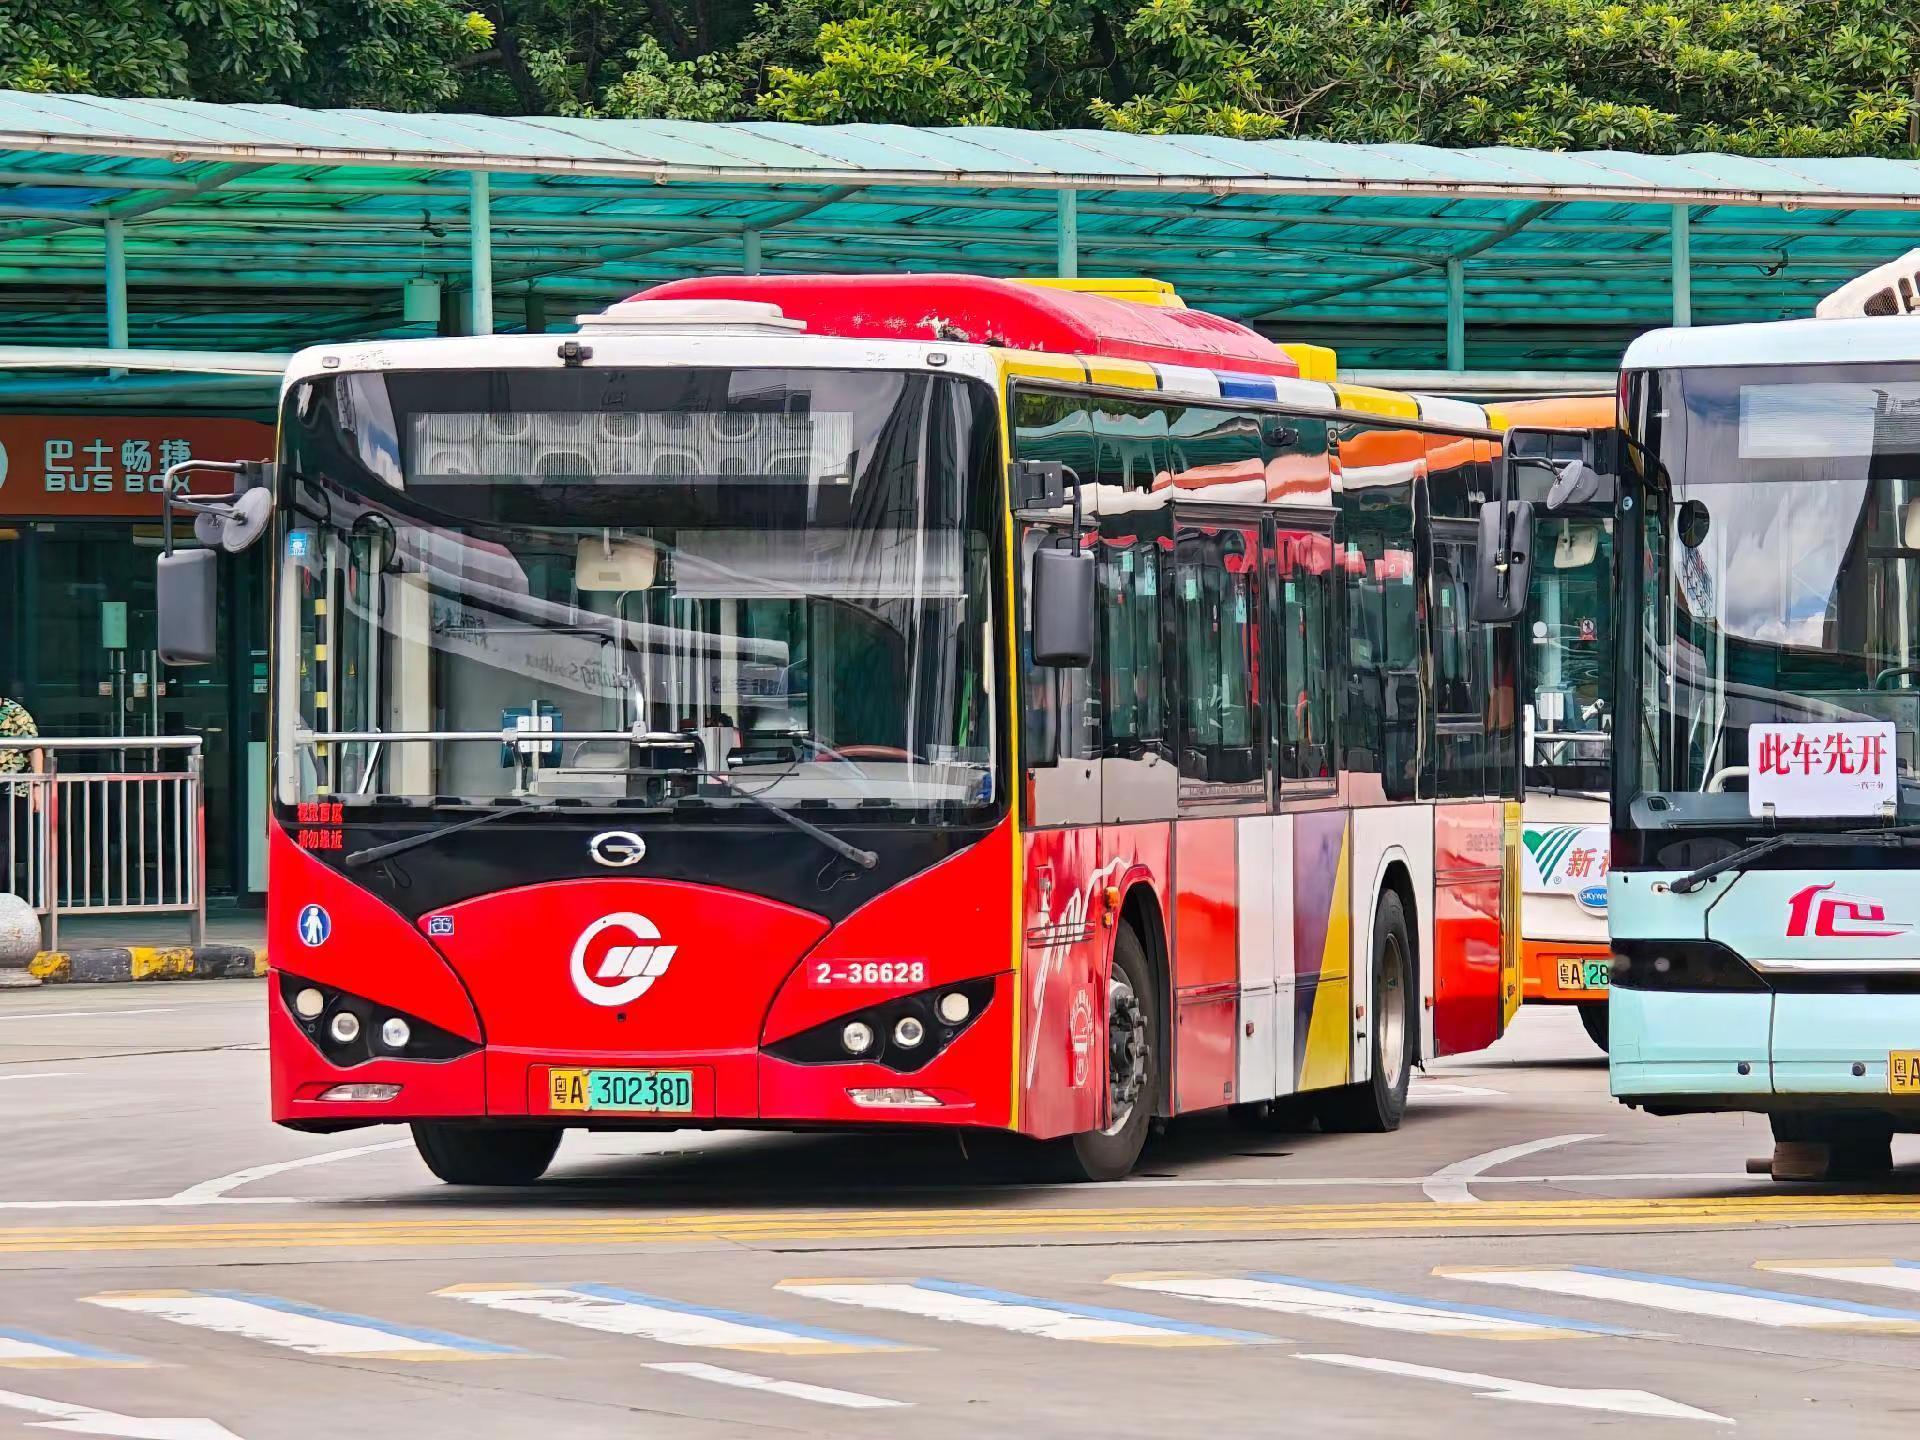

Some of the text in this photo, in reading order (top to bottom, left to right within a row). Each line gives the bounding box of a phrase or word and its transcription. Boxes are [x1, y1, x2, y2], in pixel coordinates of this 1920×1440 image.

[45, 439, 191, 473] 巴士畅捷
[45, 473, 112, 492] BUS
[1759, 732, 1887, 776] 此车先开
[817, 962, 924, 984] 2-36628
